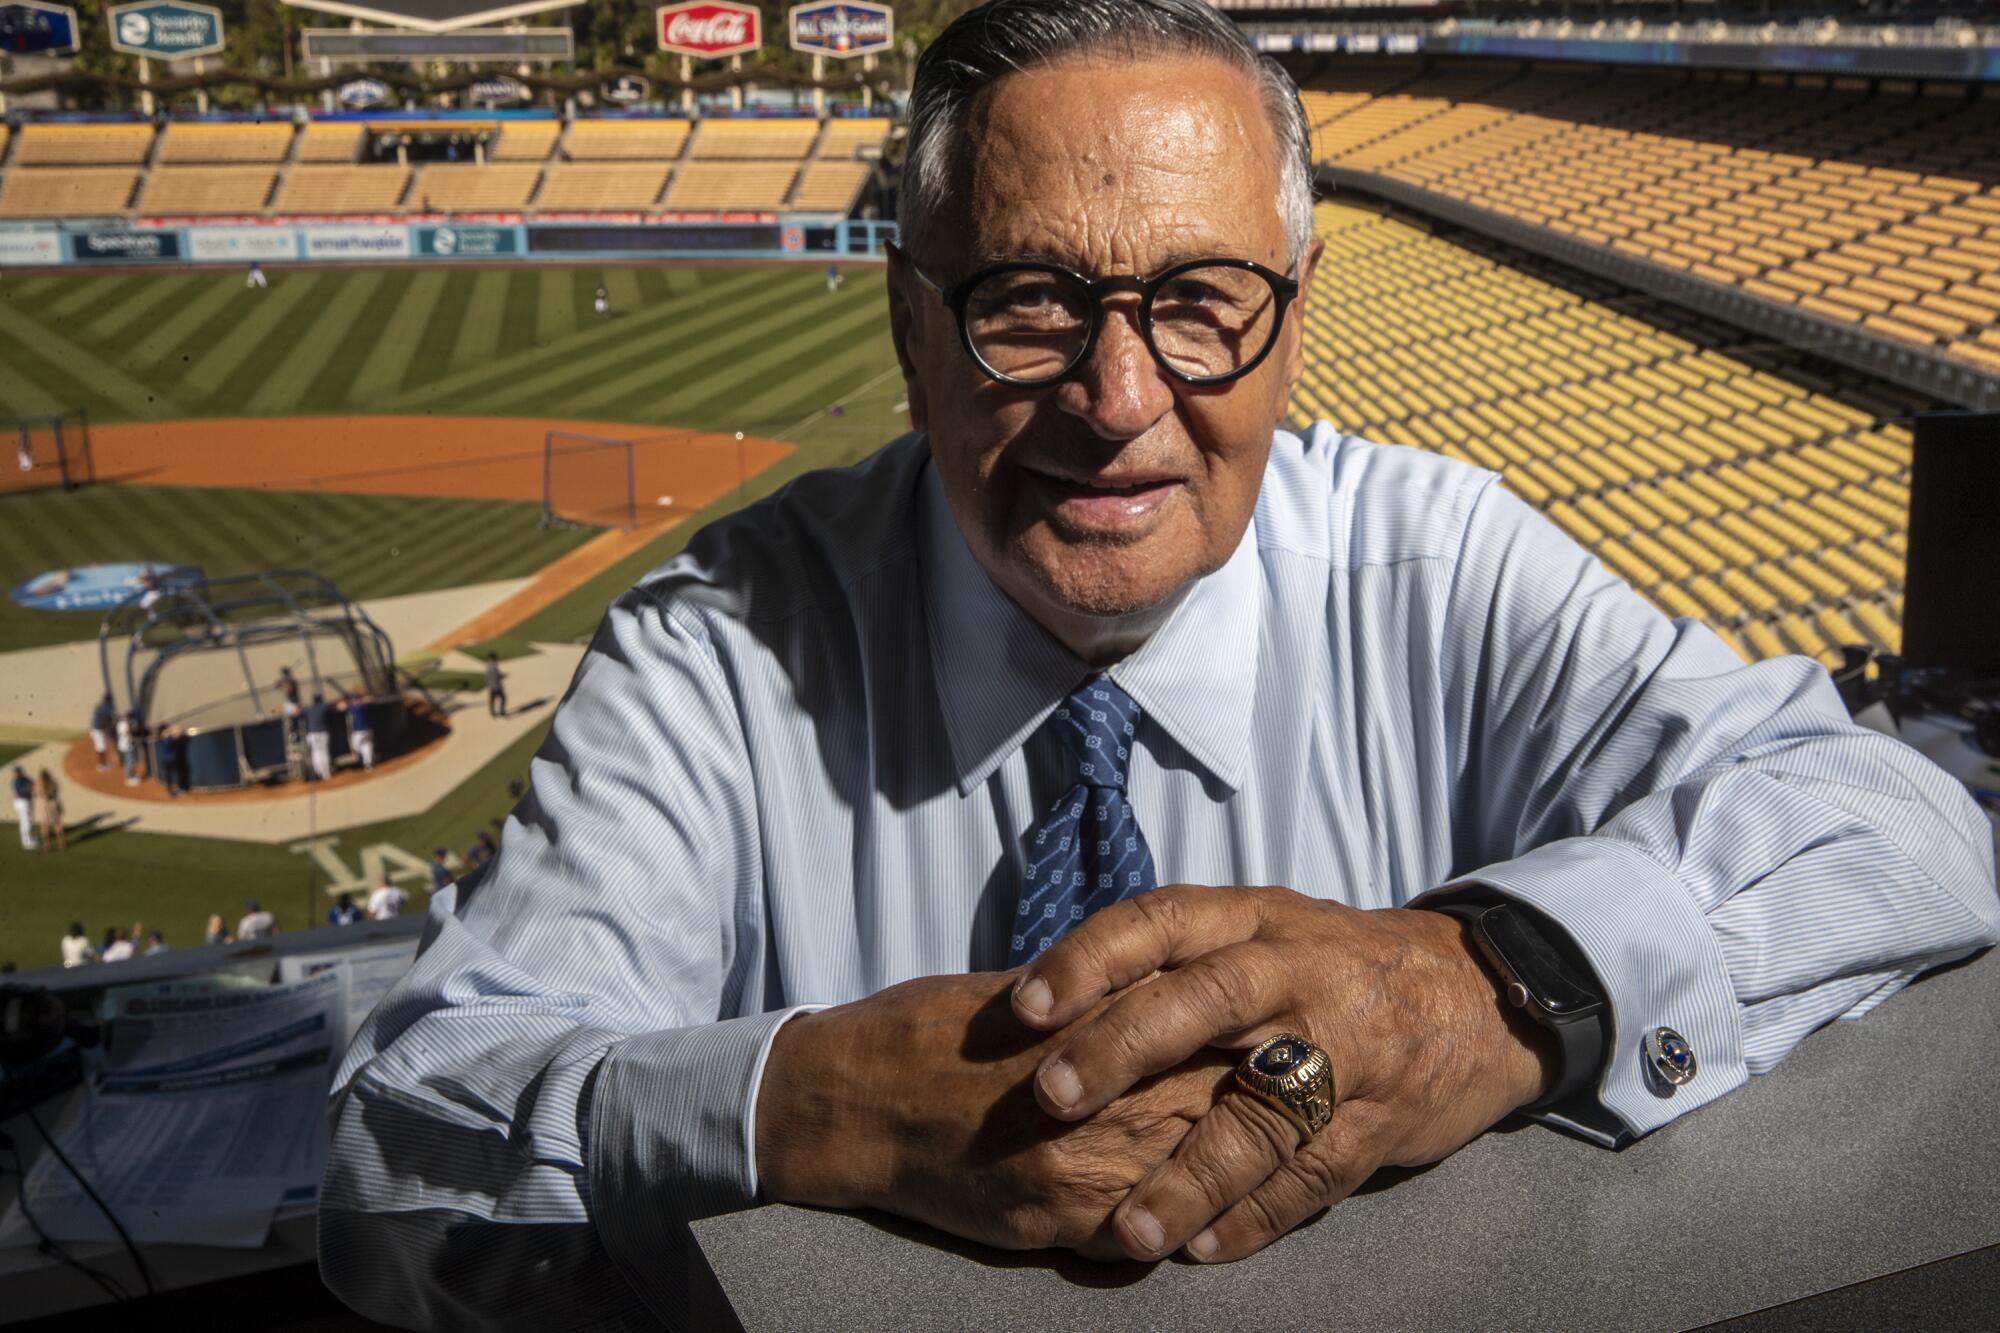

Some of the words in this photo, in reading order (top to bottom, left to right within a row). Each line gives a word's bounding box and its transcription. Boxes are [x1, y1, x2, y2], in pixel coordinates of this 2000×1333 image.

[151, 13, 209, 32] Security
[667, 12, 748, 44] Coca-Cola
[153, 30, 207, 46] Benefit
[1029, 882, 1052, 904] CHANEL
